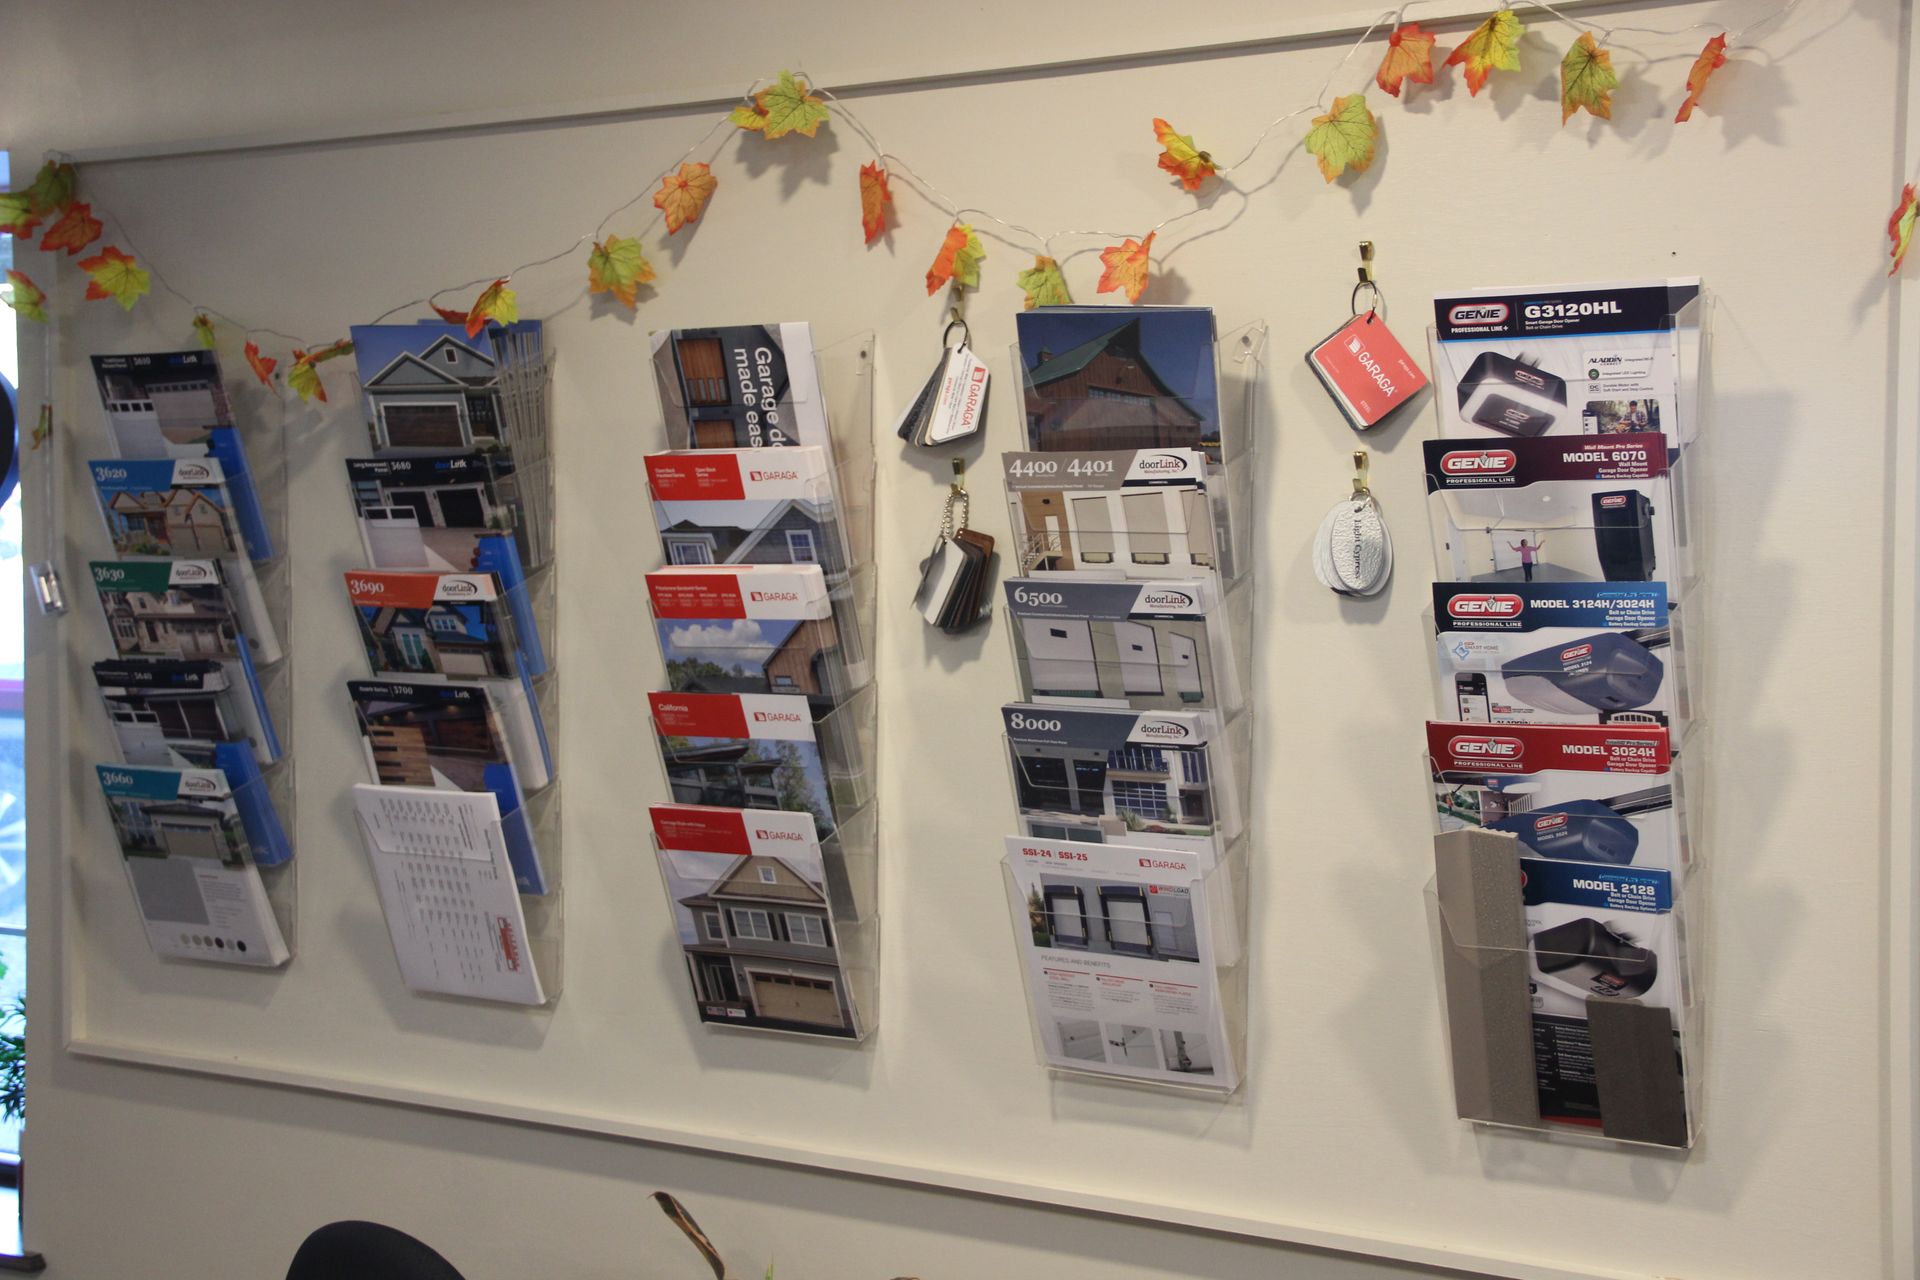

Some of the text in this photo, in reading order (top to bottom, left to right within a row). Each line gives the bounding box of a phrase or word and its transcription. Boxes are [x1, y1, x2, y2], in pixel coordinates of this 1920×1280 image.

[1455, 309, 1500, 320] GENIE
[1524, 301, 1622, 318] G3120HL
[1356, 350, 1397, 397] GARAGA
[755, 347, 779, 424] Garage
[734, 348, 763, 448] made eas
[960, 382, 980, 427] GARAGA
[1563, 450, 1646, 462] MODEL 6070
[1009, 459, 1114, 477] 4400 4401
[1139, 458, 1180, 469] doorLink
[1447, 456, 1507, 470] GENIE
[96, 467, 127, 481] 3620
[763, 471, 797, 480] GARAGA
[1353, 544, 1362, 579] Cypress
[95, 567, 125, 581] 3630
[351, 579, 384, 595] 3690
[763, 592, 797, 601] GARAGA
[1014, 587, 1062, 606] 6500
[1145, 595, 1185, 604] doorLink
[1454, 600, 1515, 612] GENIE
[1530, 599, 1655, 609] MODEL 3124H/3024H
[659, 704, 688, 712] California
[766, 712, 801, 722] GARAGA
[1011, 713, 1061, 731] 8000
[1141, 725, 1182, 734] doorLink
[1455, 742, 1515, 755] GENIE
[1562, 745, 1655, 757] MODEL 3024H
[103, 772, 133, 785] 3660
[1537, 816, 1564, 828] GENIE
[770, 831, 803, 841] GARAGA
[1023, 848, 1088, 861] SSI-24 SSI-25
[1152, 860, 1186, 870] GARAGA
[1573, 879, 1618, 892] MODEL
[1621, 883, 1655, 895] 2128
[1638, 899, 1656, 907] Opener
[1041, 955, 1069, 964] FEATURES
[1083, 960, 1111, 968] BENEFITS
